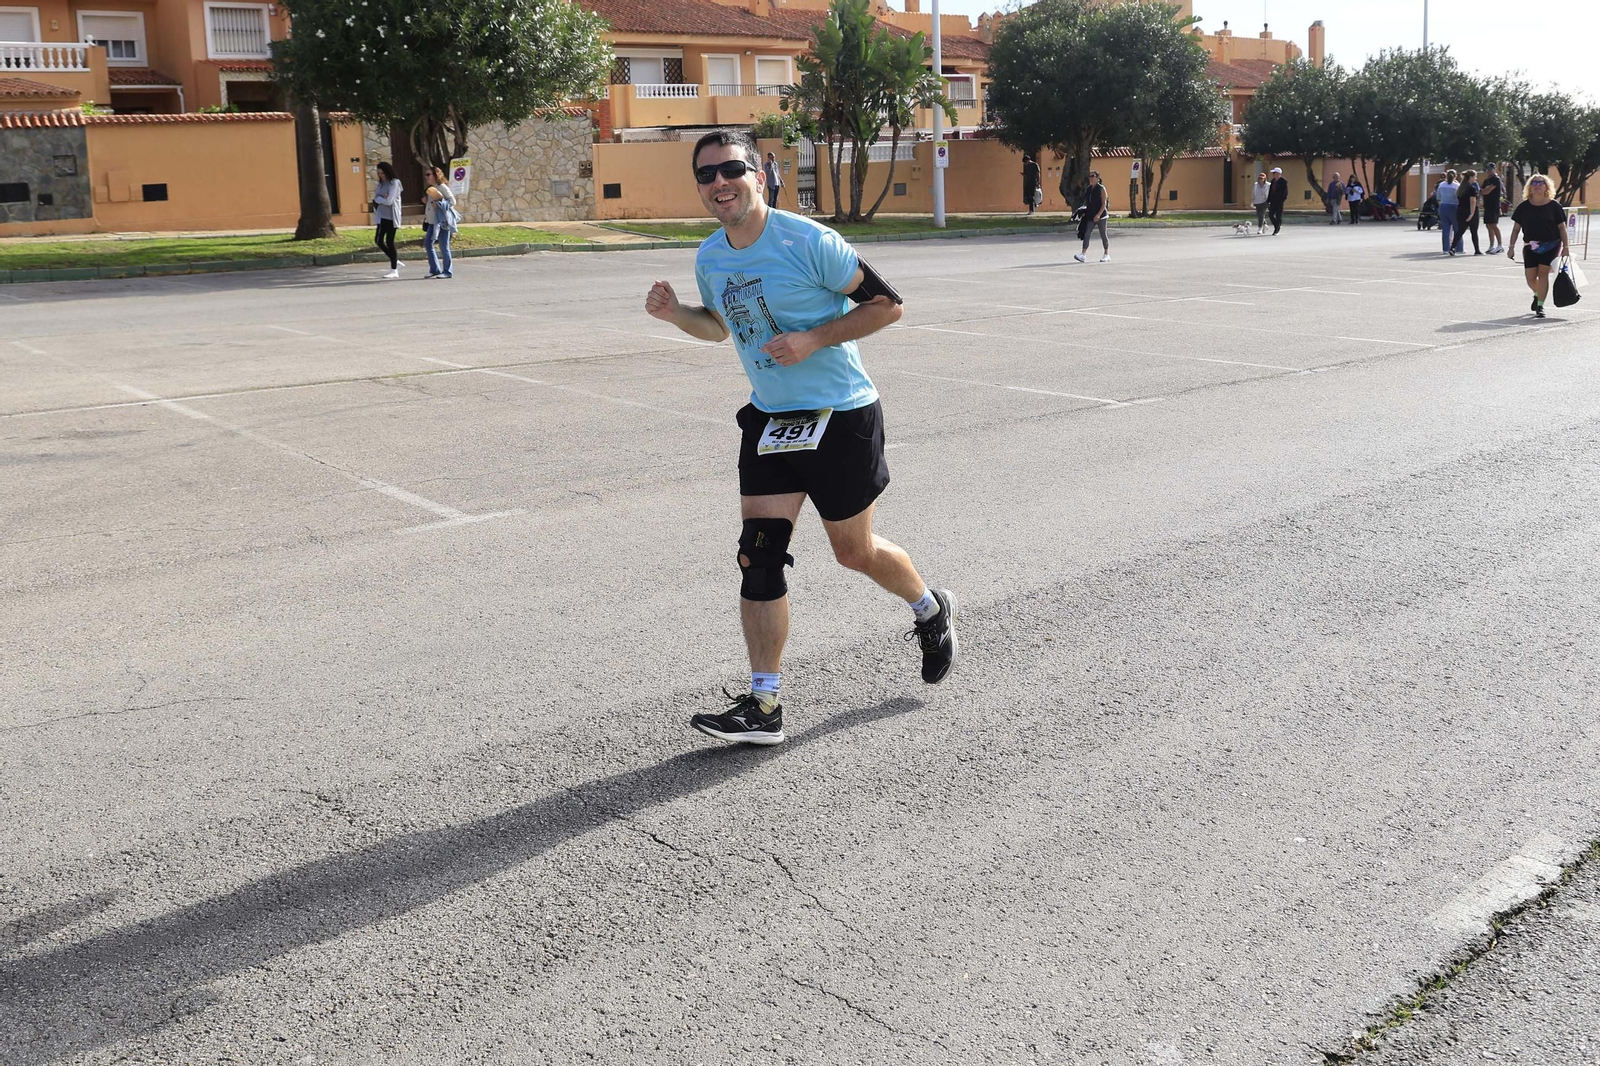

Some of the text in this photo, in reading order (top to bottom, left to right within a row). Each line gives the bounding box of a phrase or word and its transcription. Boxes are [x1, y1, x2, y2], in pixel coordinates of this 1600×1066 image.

[741, 277, 763, 289] CARRERA
[741, 283, 763, 301] URBANA
[768, 421, 819, 441] 491
